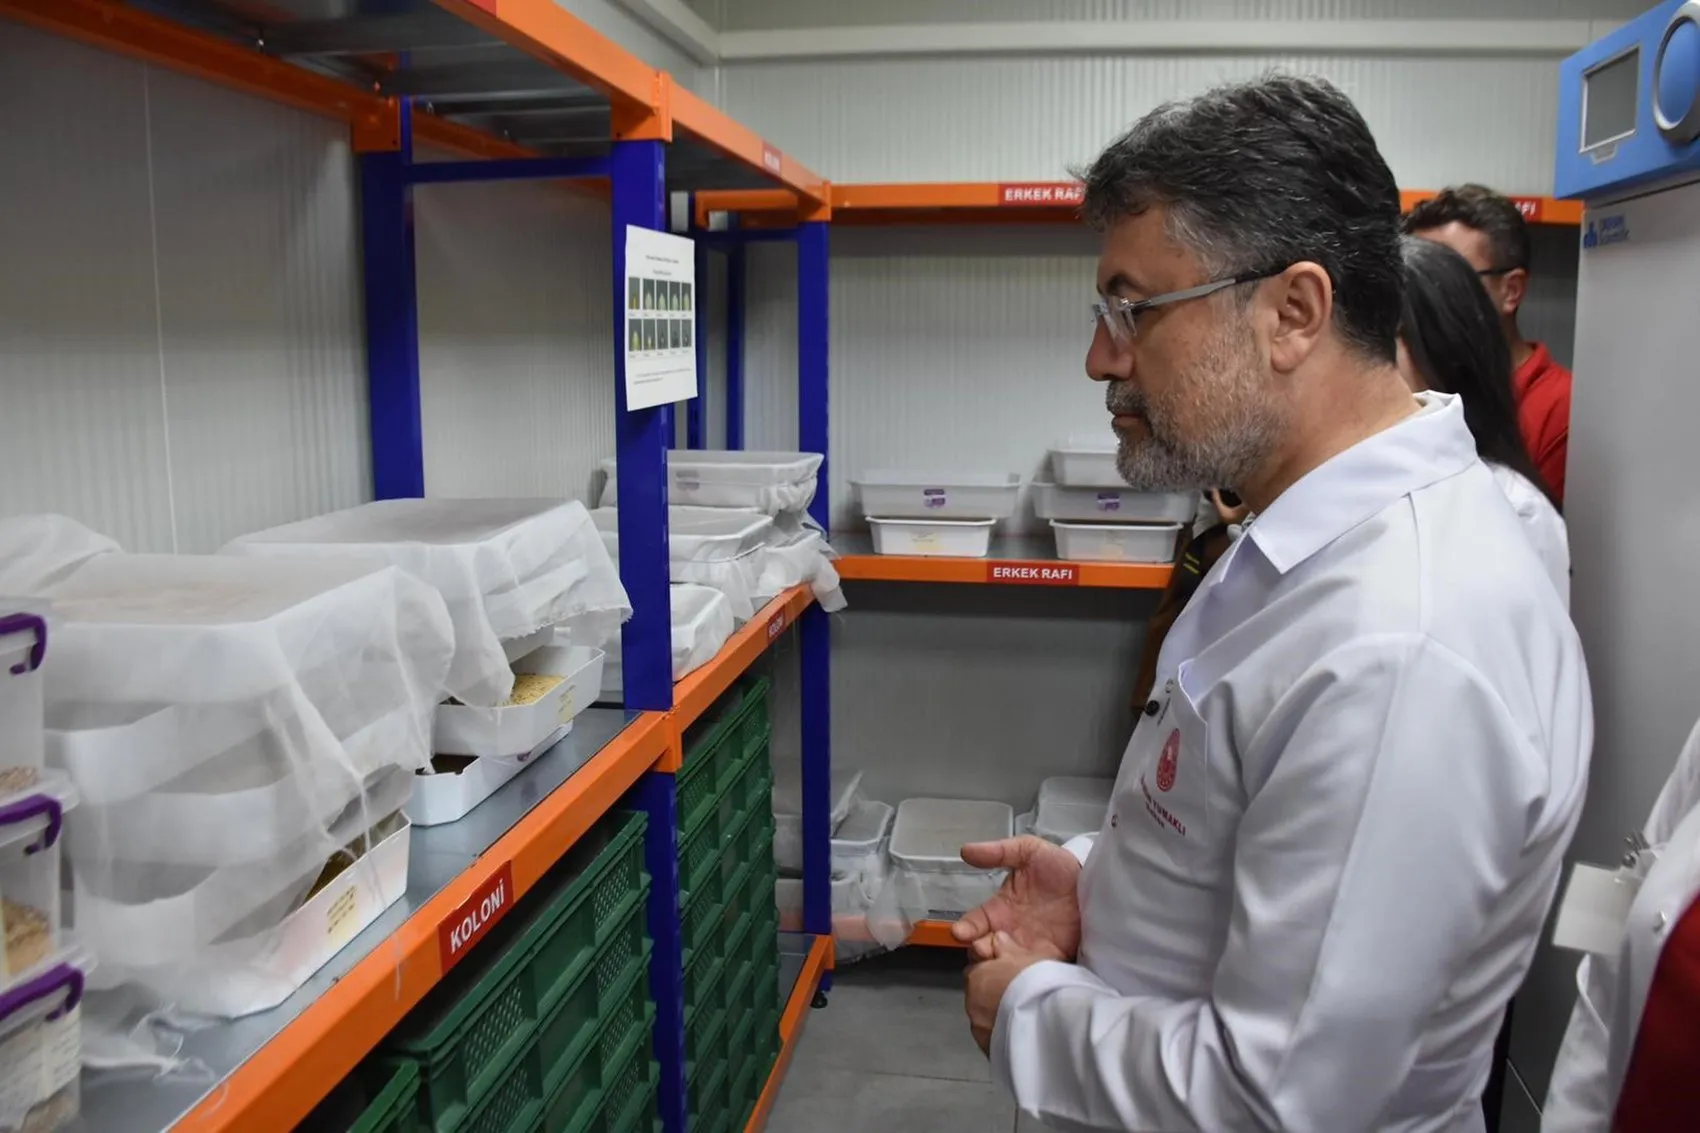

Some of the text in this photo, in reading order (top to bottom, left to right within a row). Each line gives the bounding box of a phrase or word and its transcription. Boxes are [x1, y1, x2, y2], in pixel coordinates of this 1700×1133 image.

[1004, 187, 1083, 201] ERKEK RAF
[993, 567, 1073, 580] ERKEK RAFI
[450, 878, 505, 955] KOLONİ
